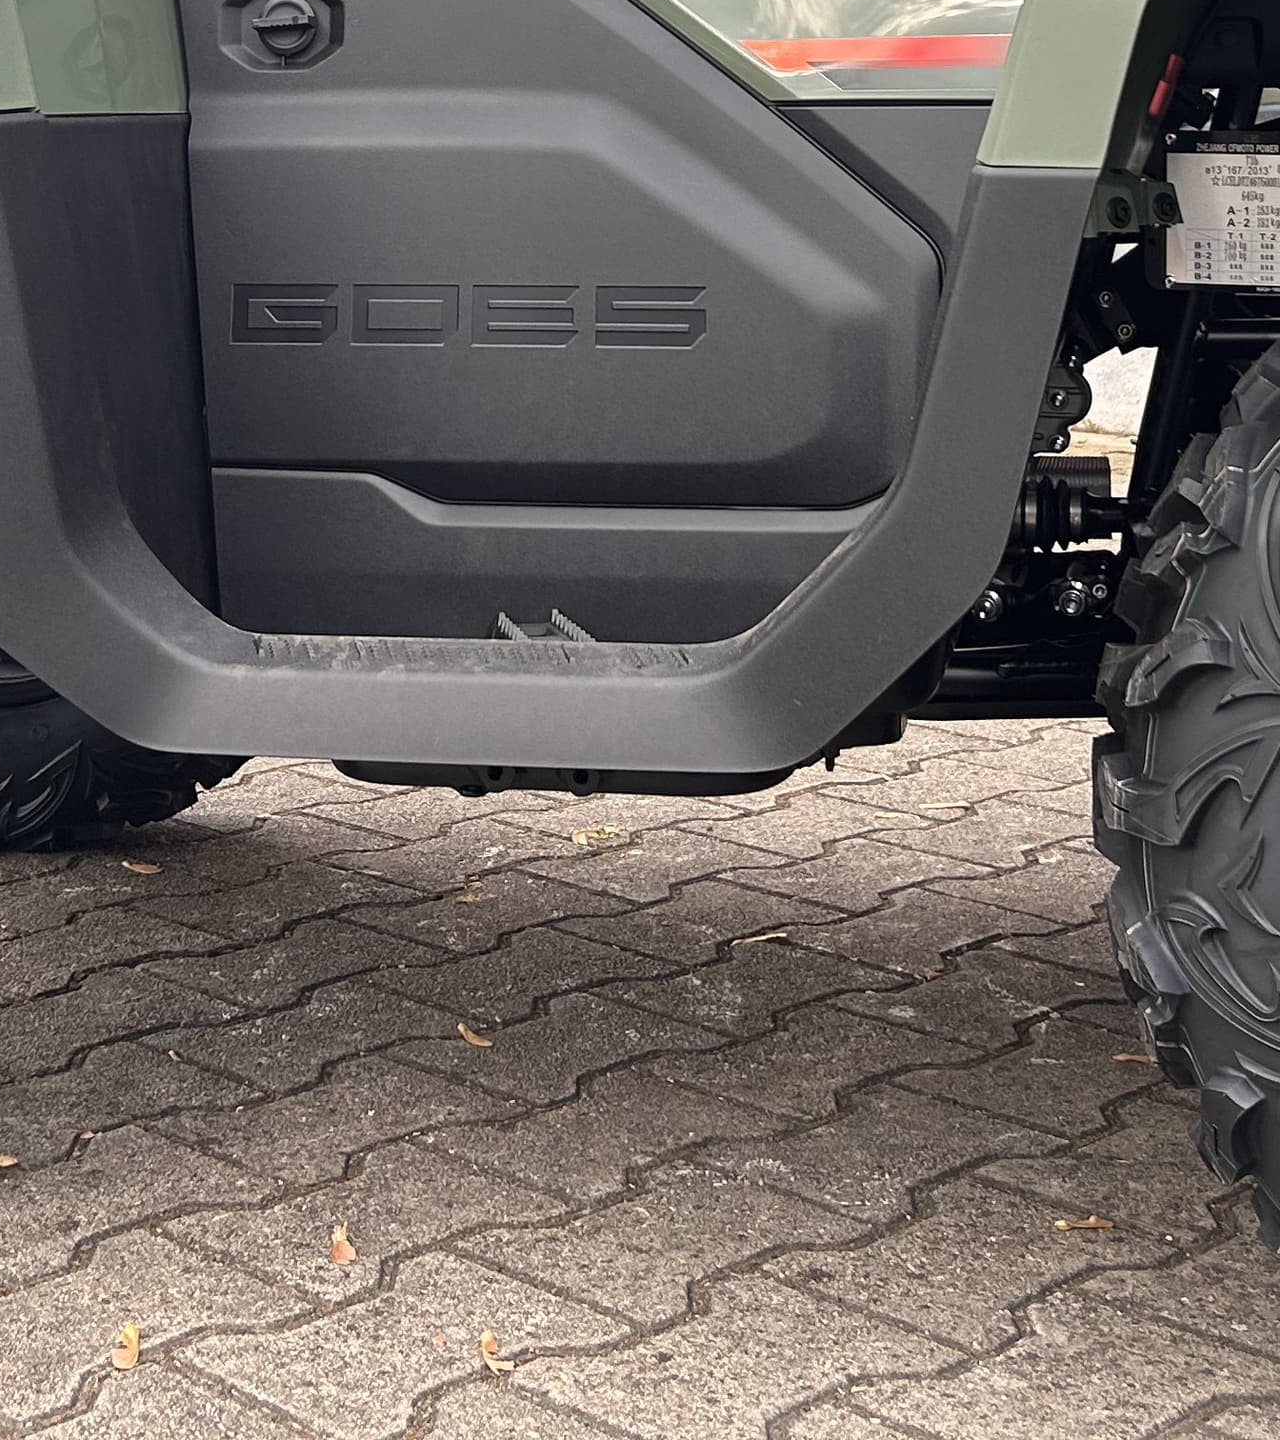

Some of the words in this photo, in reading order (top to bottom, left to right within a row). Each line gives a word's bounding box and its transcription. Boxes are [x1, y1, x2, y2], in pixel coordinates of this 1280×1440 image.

[1256, 144, 1280, 154] POWER
[1227, 232, 1244, 241] T-1
[1259, 233, 1277, 242] T-2
[1194, 242, 1211, 250] B-1
[1194, 251, 1212, 260] B-2
[1194, 262, 1212, 270] B-3
[1194, 272, 1212, 281] B-4
[230, 282, 707, 349] GOES
